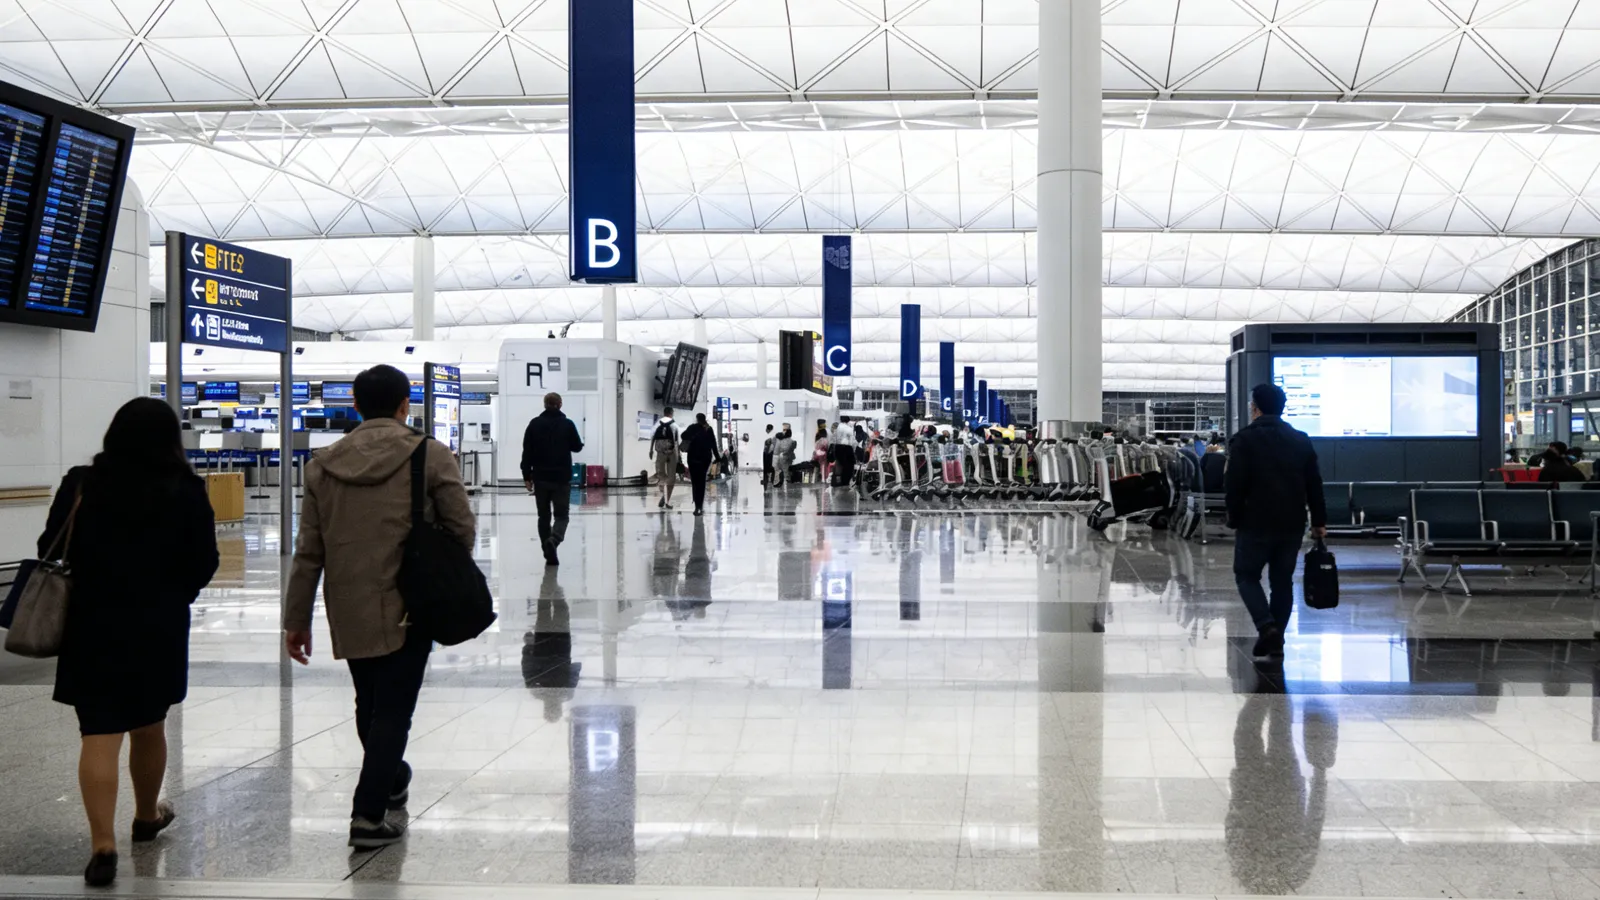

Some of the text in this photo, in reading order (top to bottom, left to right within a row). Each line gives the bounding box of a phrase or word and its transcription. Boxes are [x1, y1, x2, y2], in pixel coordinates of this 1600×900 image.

[588, 218, 620, 268] B
[826, 345, 847, 372] C
[903, 379, 918, 397] D
[763, 401, 775, 416] C
